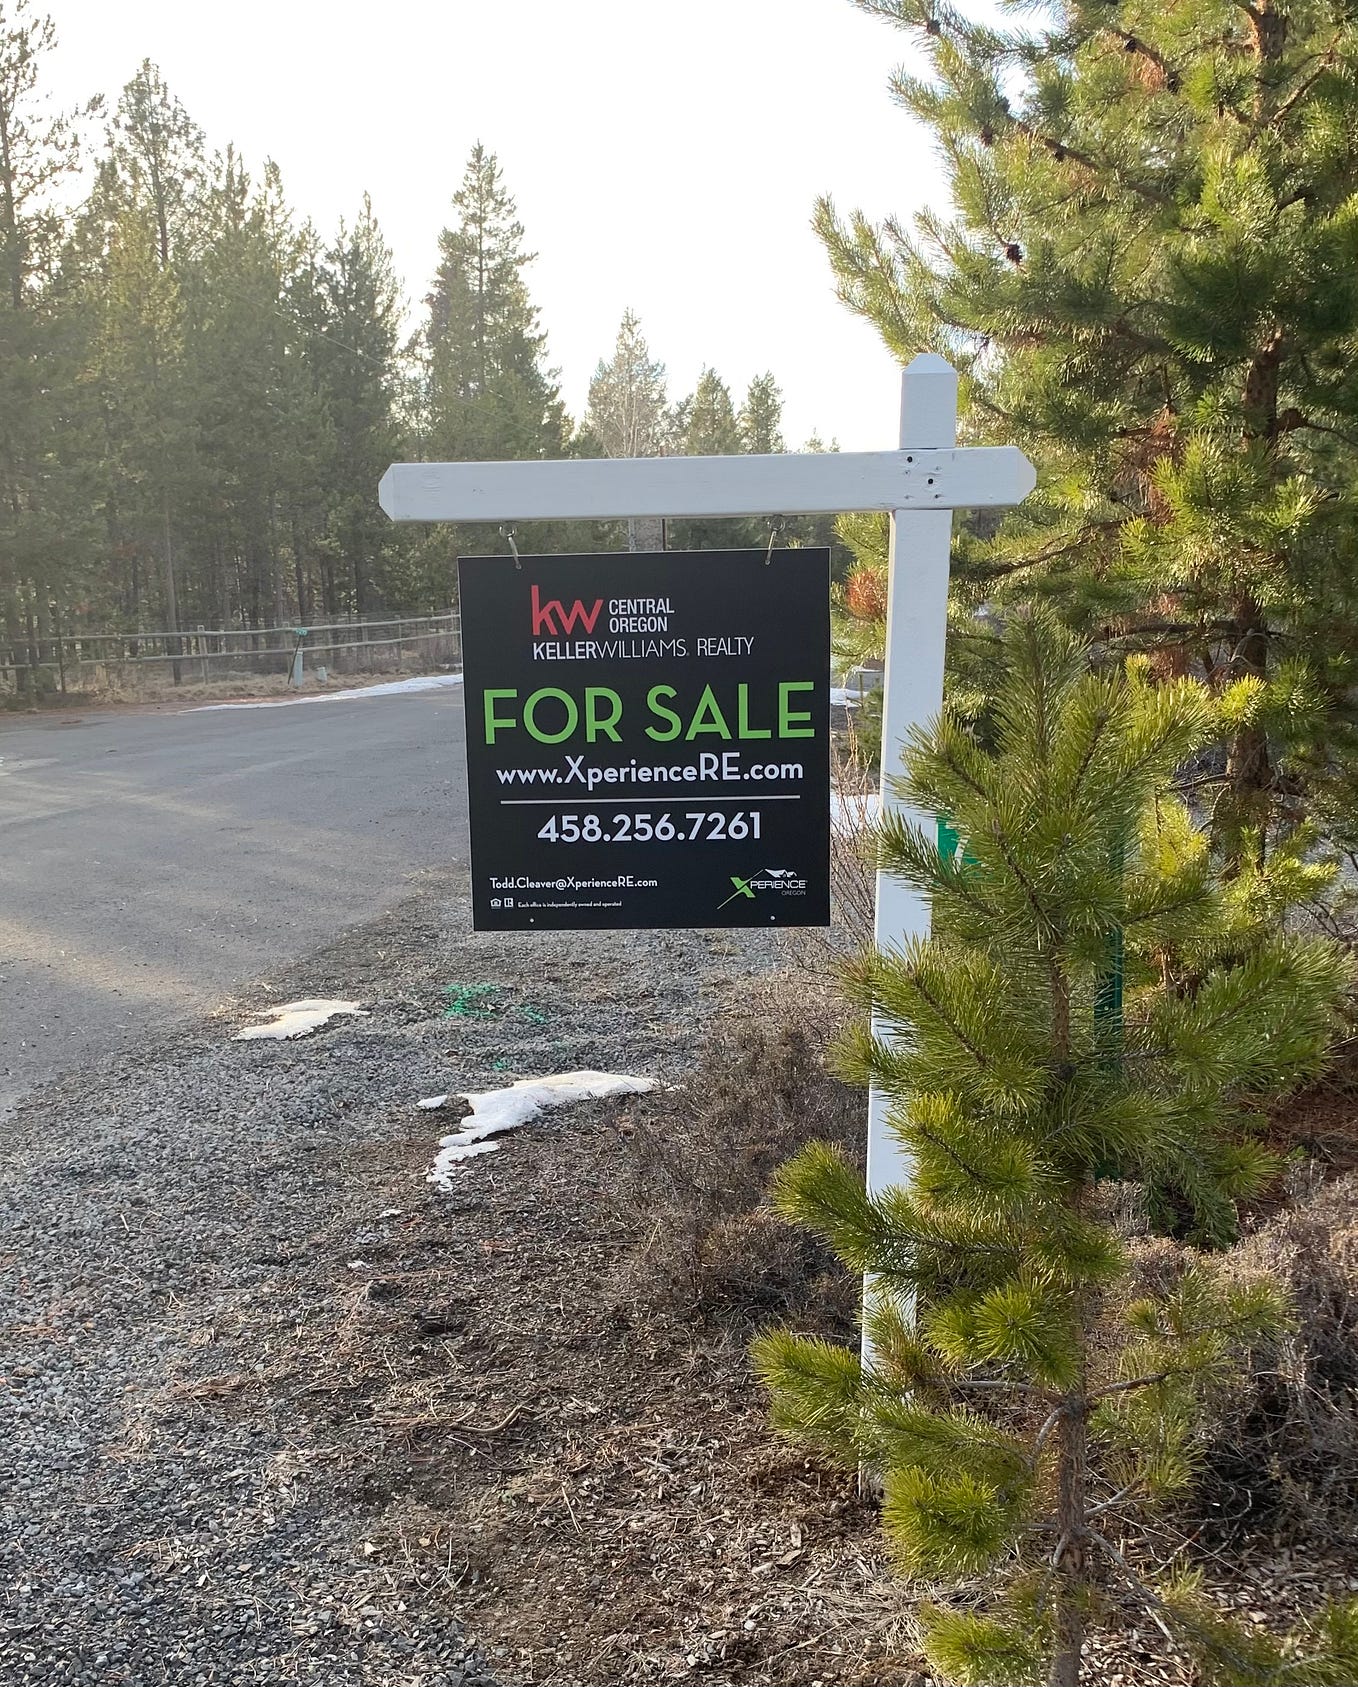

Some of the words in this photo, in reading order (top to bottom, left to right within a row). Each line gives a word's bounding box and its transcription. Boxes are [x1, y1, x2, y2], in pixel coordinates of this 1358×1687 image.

[531, 585, 604, 635] kw
[608, 598, 675, 616] CENTRAL
[609, 616, 668, 634] OREGON
[697, 636, 755, 657] REALTY
[483, 687, 623, 745] FOR
[645, 681, 815, 742] SALE
[496, 752, 804, 792] www.XperienceRE.com
[537, 812, 761, 843] 458.256.7261
[490, 875, 658, 891] Todd.Cleaver@XperienceRE.com
[730, 876, 808, 898] XPERIENCE
